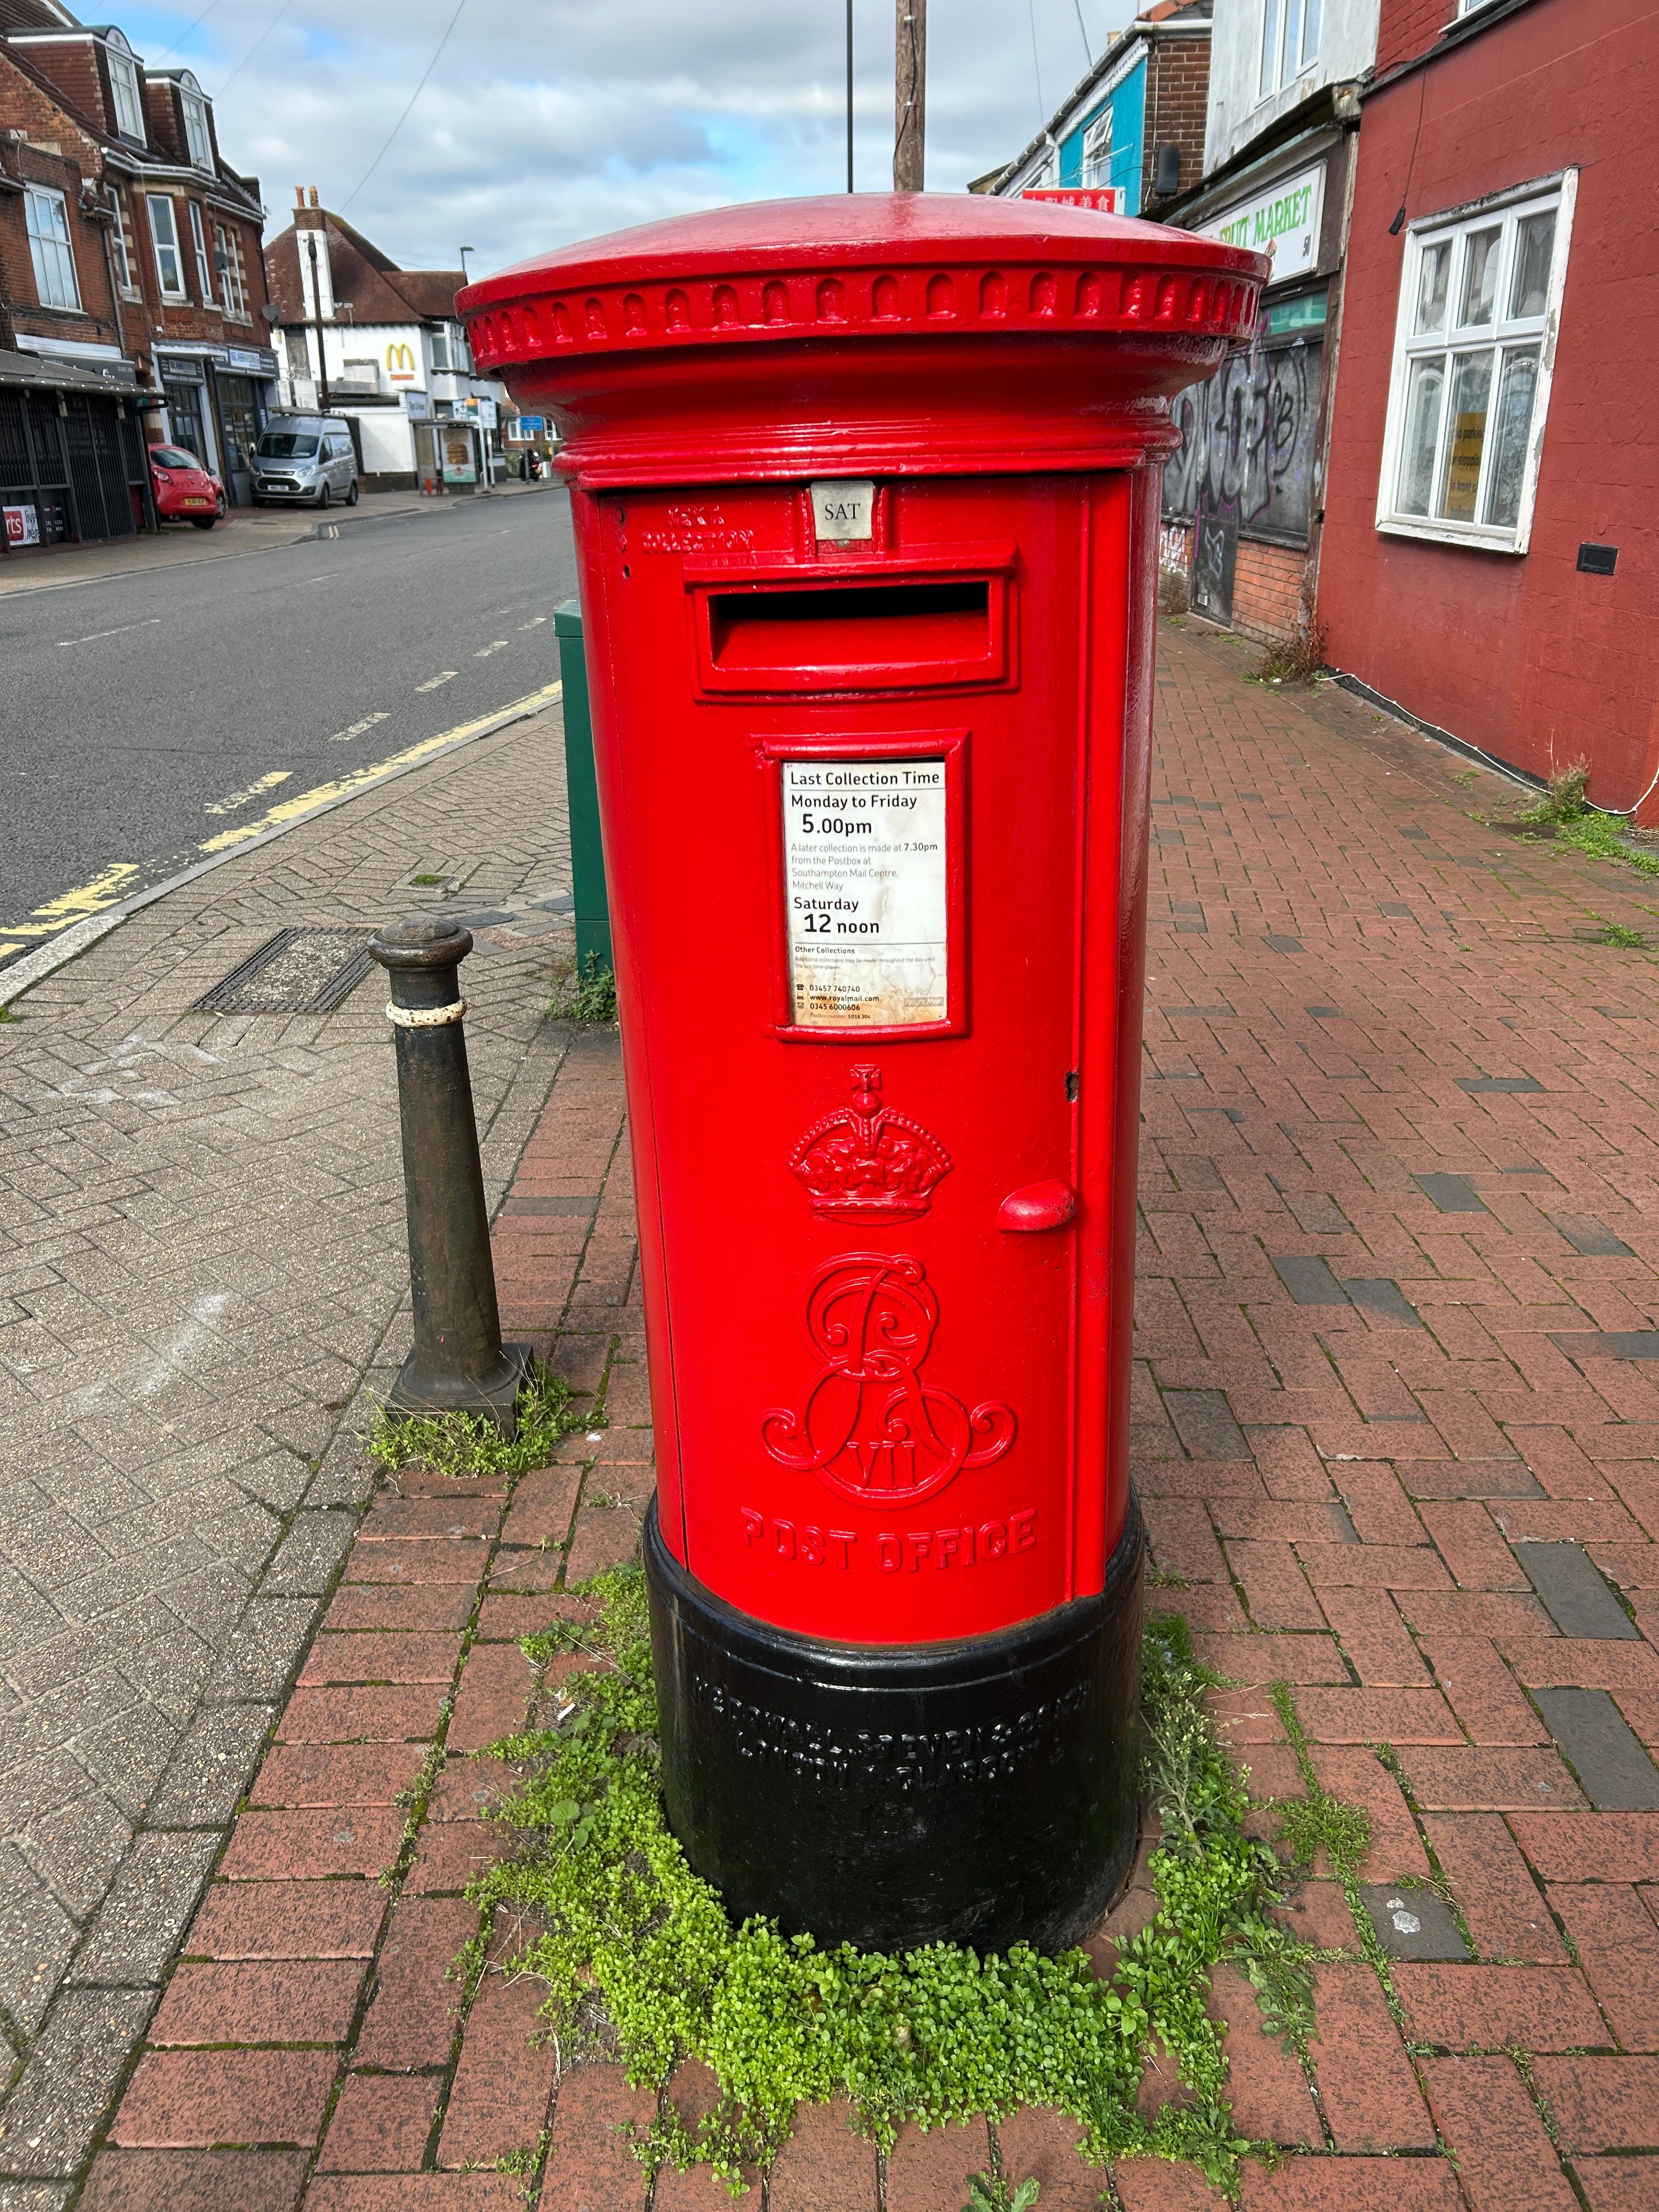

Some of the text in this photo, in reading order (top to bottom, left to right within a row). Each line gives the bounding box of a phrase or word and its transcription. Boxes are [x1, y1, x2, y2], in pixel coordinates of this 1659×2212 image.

[1252, 183, 1312, 246] MARKET
[1302, 234, 1311, 257] 50
[1458, 453, 1481, 470] stoppin
[25, 510, 36, 524] live
[825, 503, 861, 521] SAT
[791, 771, 939, 785] Last Collection Time
[791, 794, 917, 810] Monday to Friday
[803, 814, 872, 837] 5.00pm
[799, 844, 816, 852] later
[819, 844, 857, 853] collection
[860, 844, 866, 852] is
[868, 843, 891, 852] made
[893, 844, 901, 852] at
[904, 843, 938, 853] 7.30pm
[791, 856, 811, 865] from
[813, 856, 826, 865] the
[828, 856, 861, 865] Postbox
[792, 869, 899, 878] Southampton Mail Centre,
[792, 881, 843, 891] Mitchell Way
[794, 897, 859, 912] Saturday
[804, 913, 879, 933] 12 noon
[795, 946, 814, 954] Other
[834, 985, 860, 993] 740740
[810, 995, 879, 1003] www.royalmail.com
[829, 1003, 860, 1011] 6000606
[847, 1441, 917, 1488] VII
[740, 1506, 1037, 1573] POST OFFICE
[896, 1737, 1041, 1791] GLASGOW
